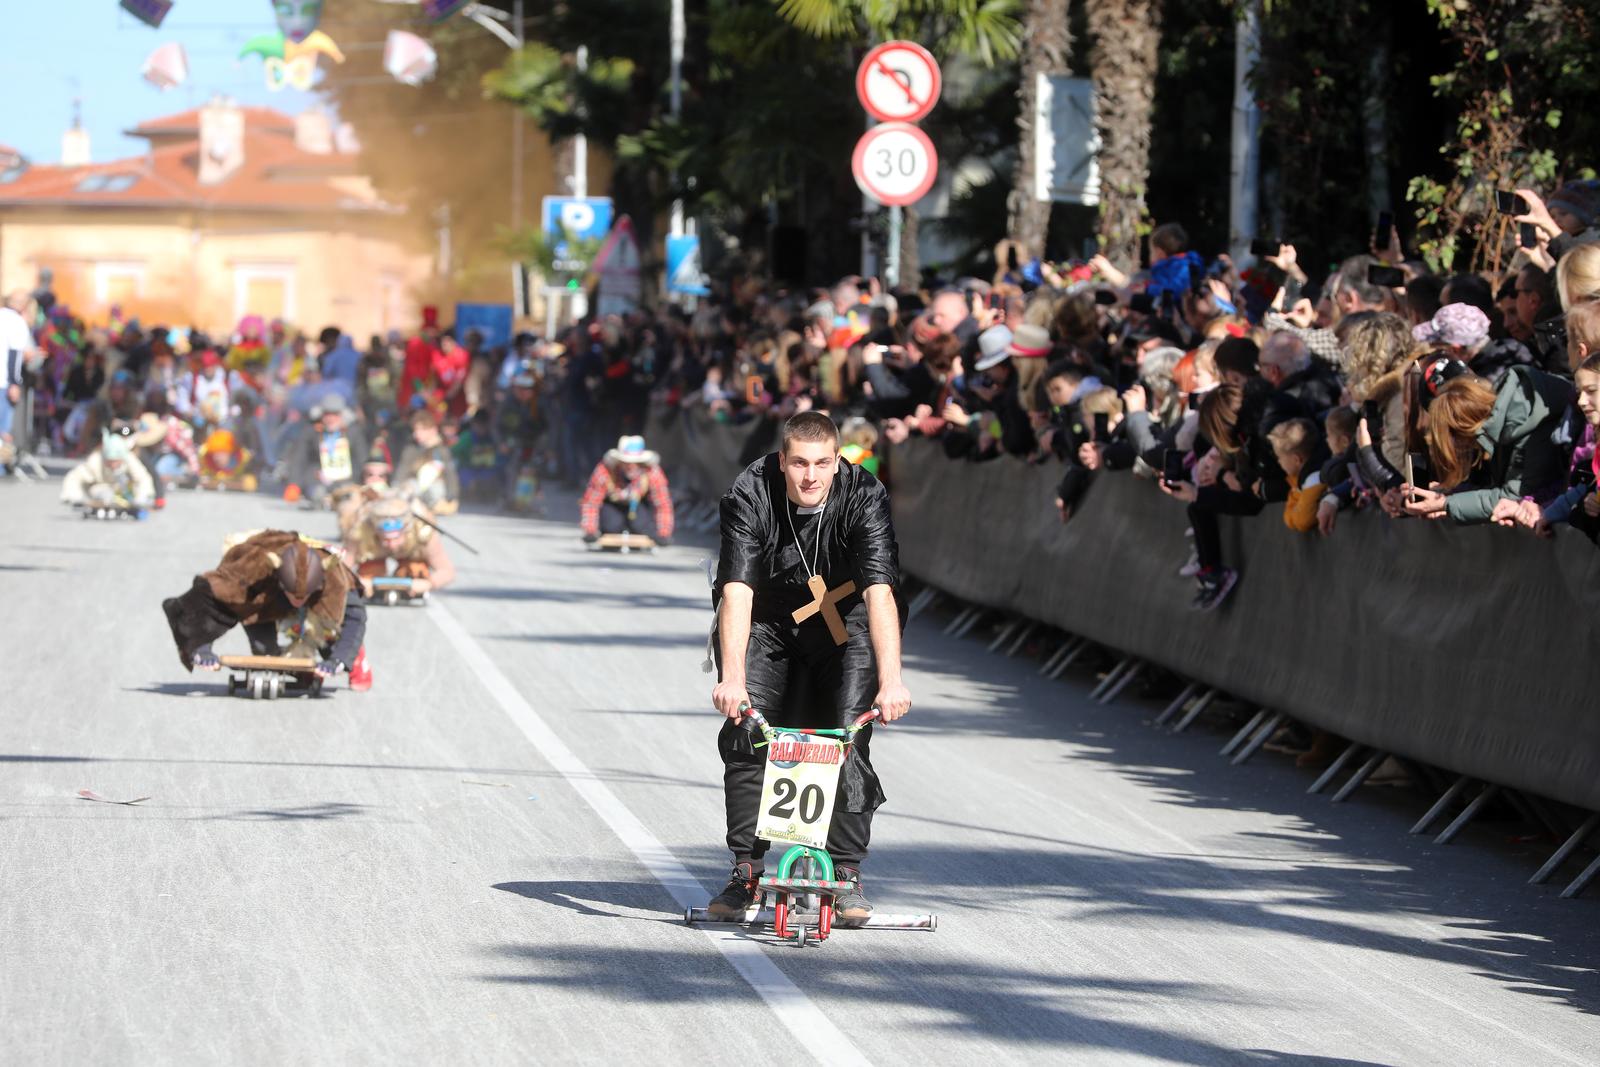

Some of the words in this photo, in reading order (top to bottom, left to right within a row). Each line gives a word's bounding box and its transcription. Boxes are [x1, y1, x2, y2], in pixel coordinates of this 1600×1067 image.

[875, 148, 916, 178] 30
[768, 741, 840, 765] BALINJERADA
[768, 777, 825, 824] 20
